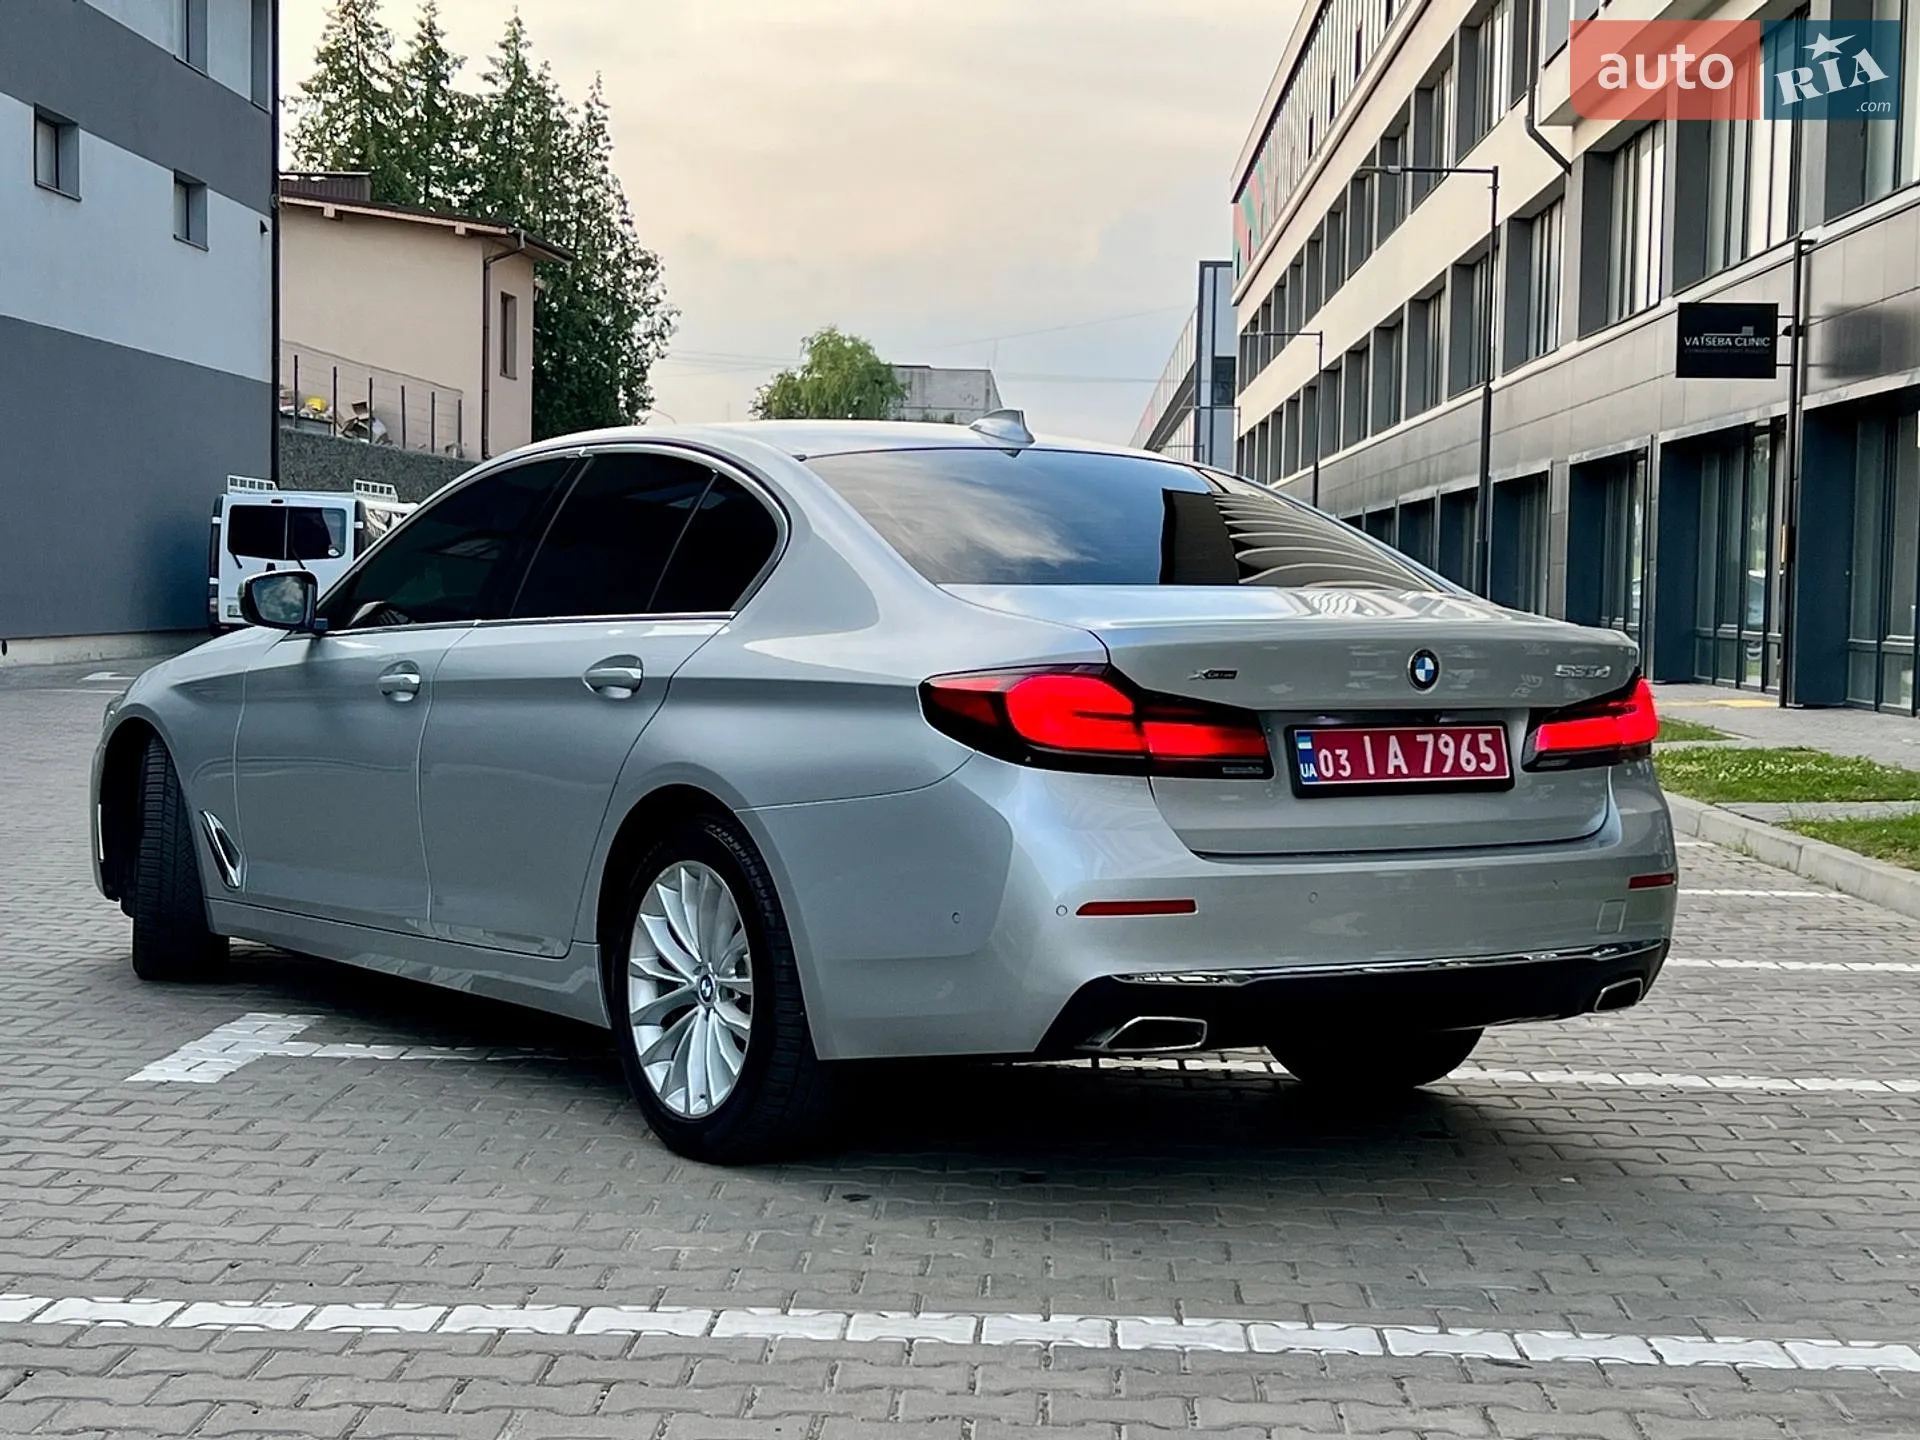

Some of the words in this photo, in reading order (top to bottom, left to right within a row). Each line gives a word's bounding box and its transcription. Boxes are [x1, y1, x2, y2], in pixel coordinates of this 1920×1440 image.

[1683, 336, 1733, 347] VATSEBA
[1734, 336, 1771, 347] CLINIC
[1318, 748, 1351, 778] 03
[1363, 734, 1409, 775] IA
[1415, 733, 1497, 774] 7965
[1301, 763, 1318, 778] UA
